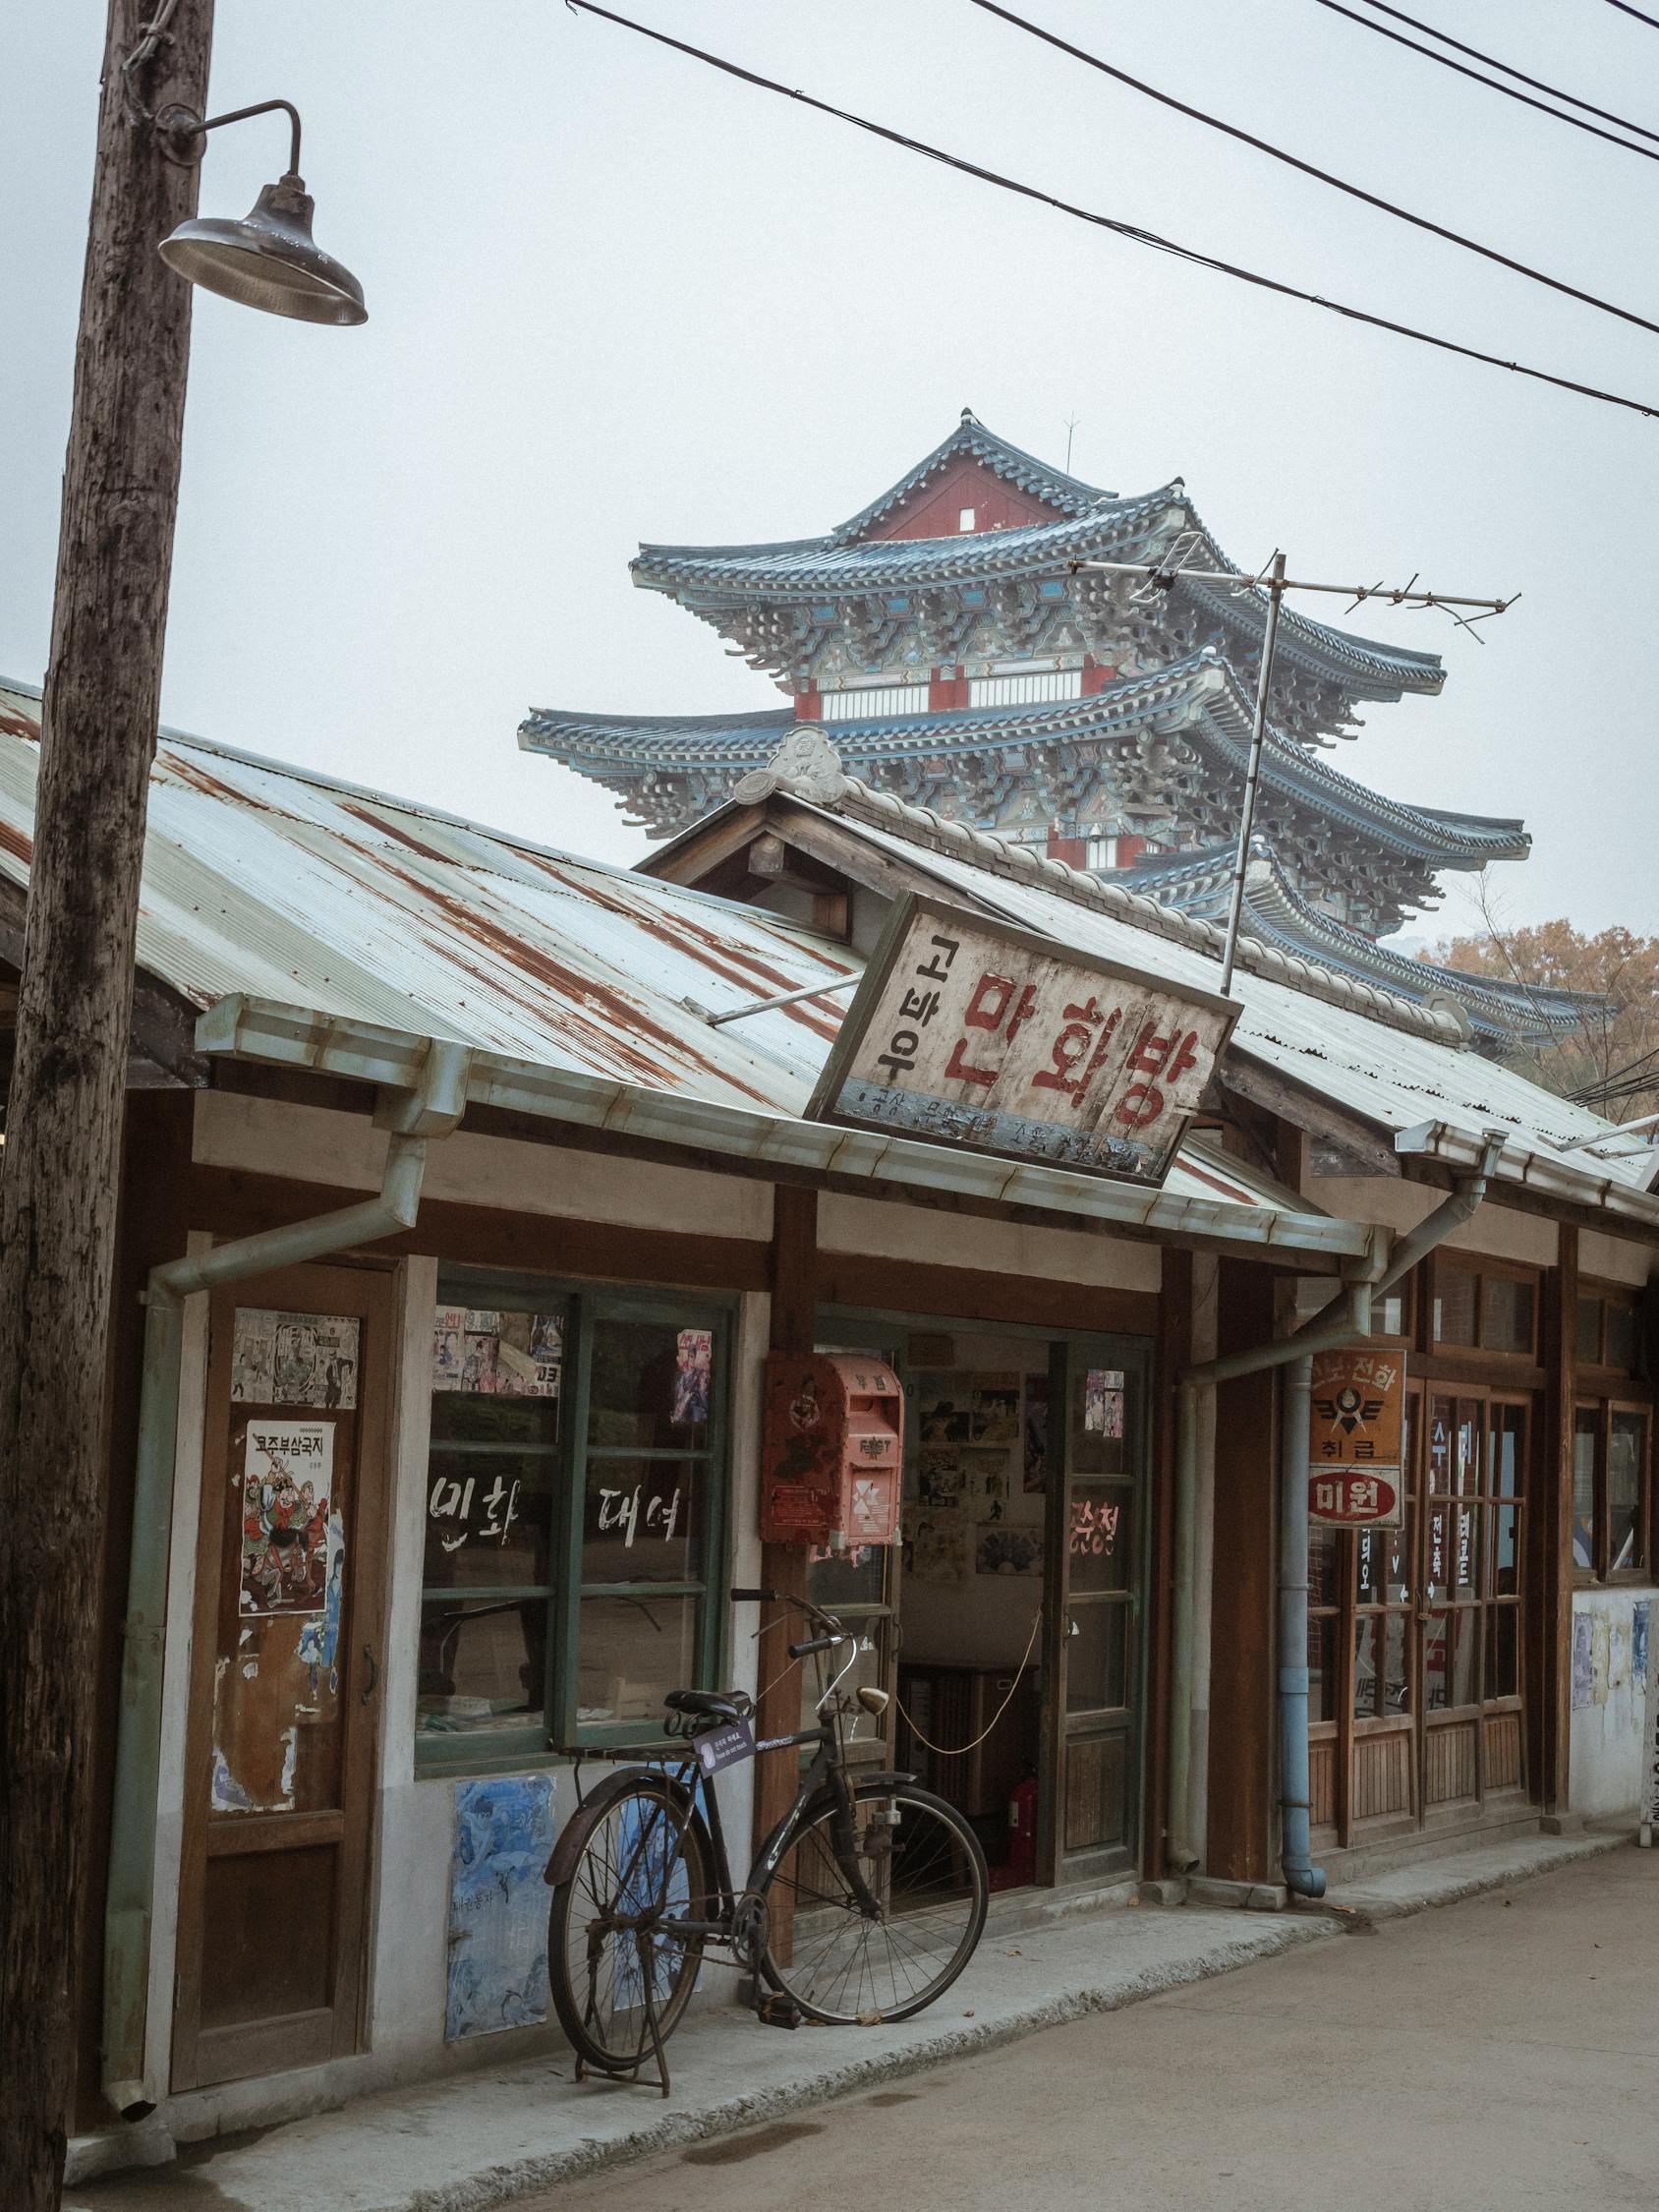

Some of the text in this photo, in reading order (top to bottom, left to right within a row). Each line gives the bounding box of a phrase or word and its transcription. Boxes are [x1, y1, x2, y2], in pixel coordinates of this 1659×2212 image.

[944, 973, 1197, 1127] 만화방
[1351, 1357, 1397, 1391] 전화
[256, 1435, 323, 1457] 코주부삼국지
[1322, 1440, 1375, 1459] 취급
[429, 1477, 680, 1551] 만화 대여
[1316, 1480, 1379, 1514] 미원
